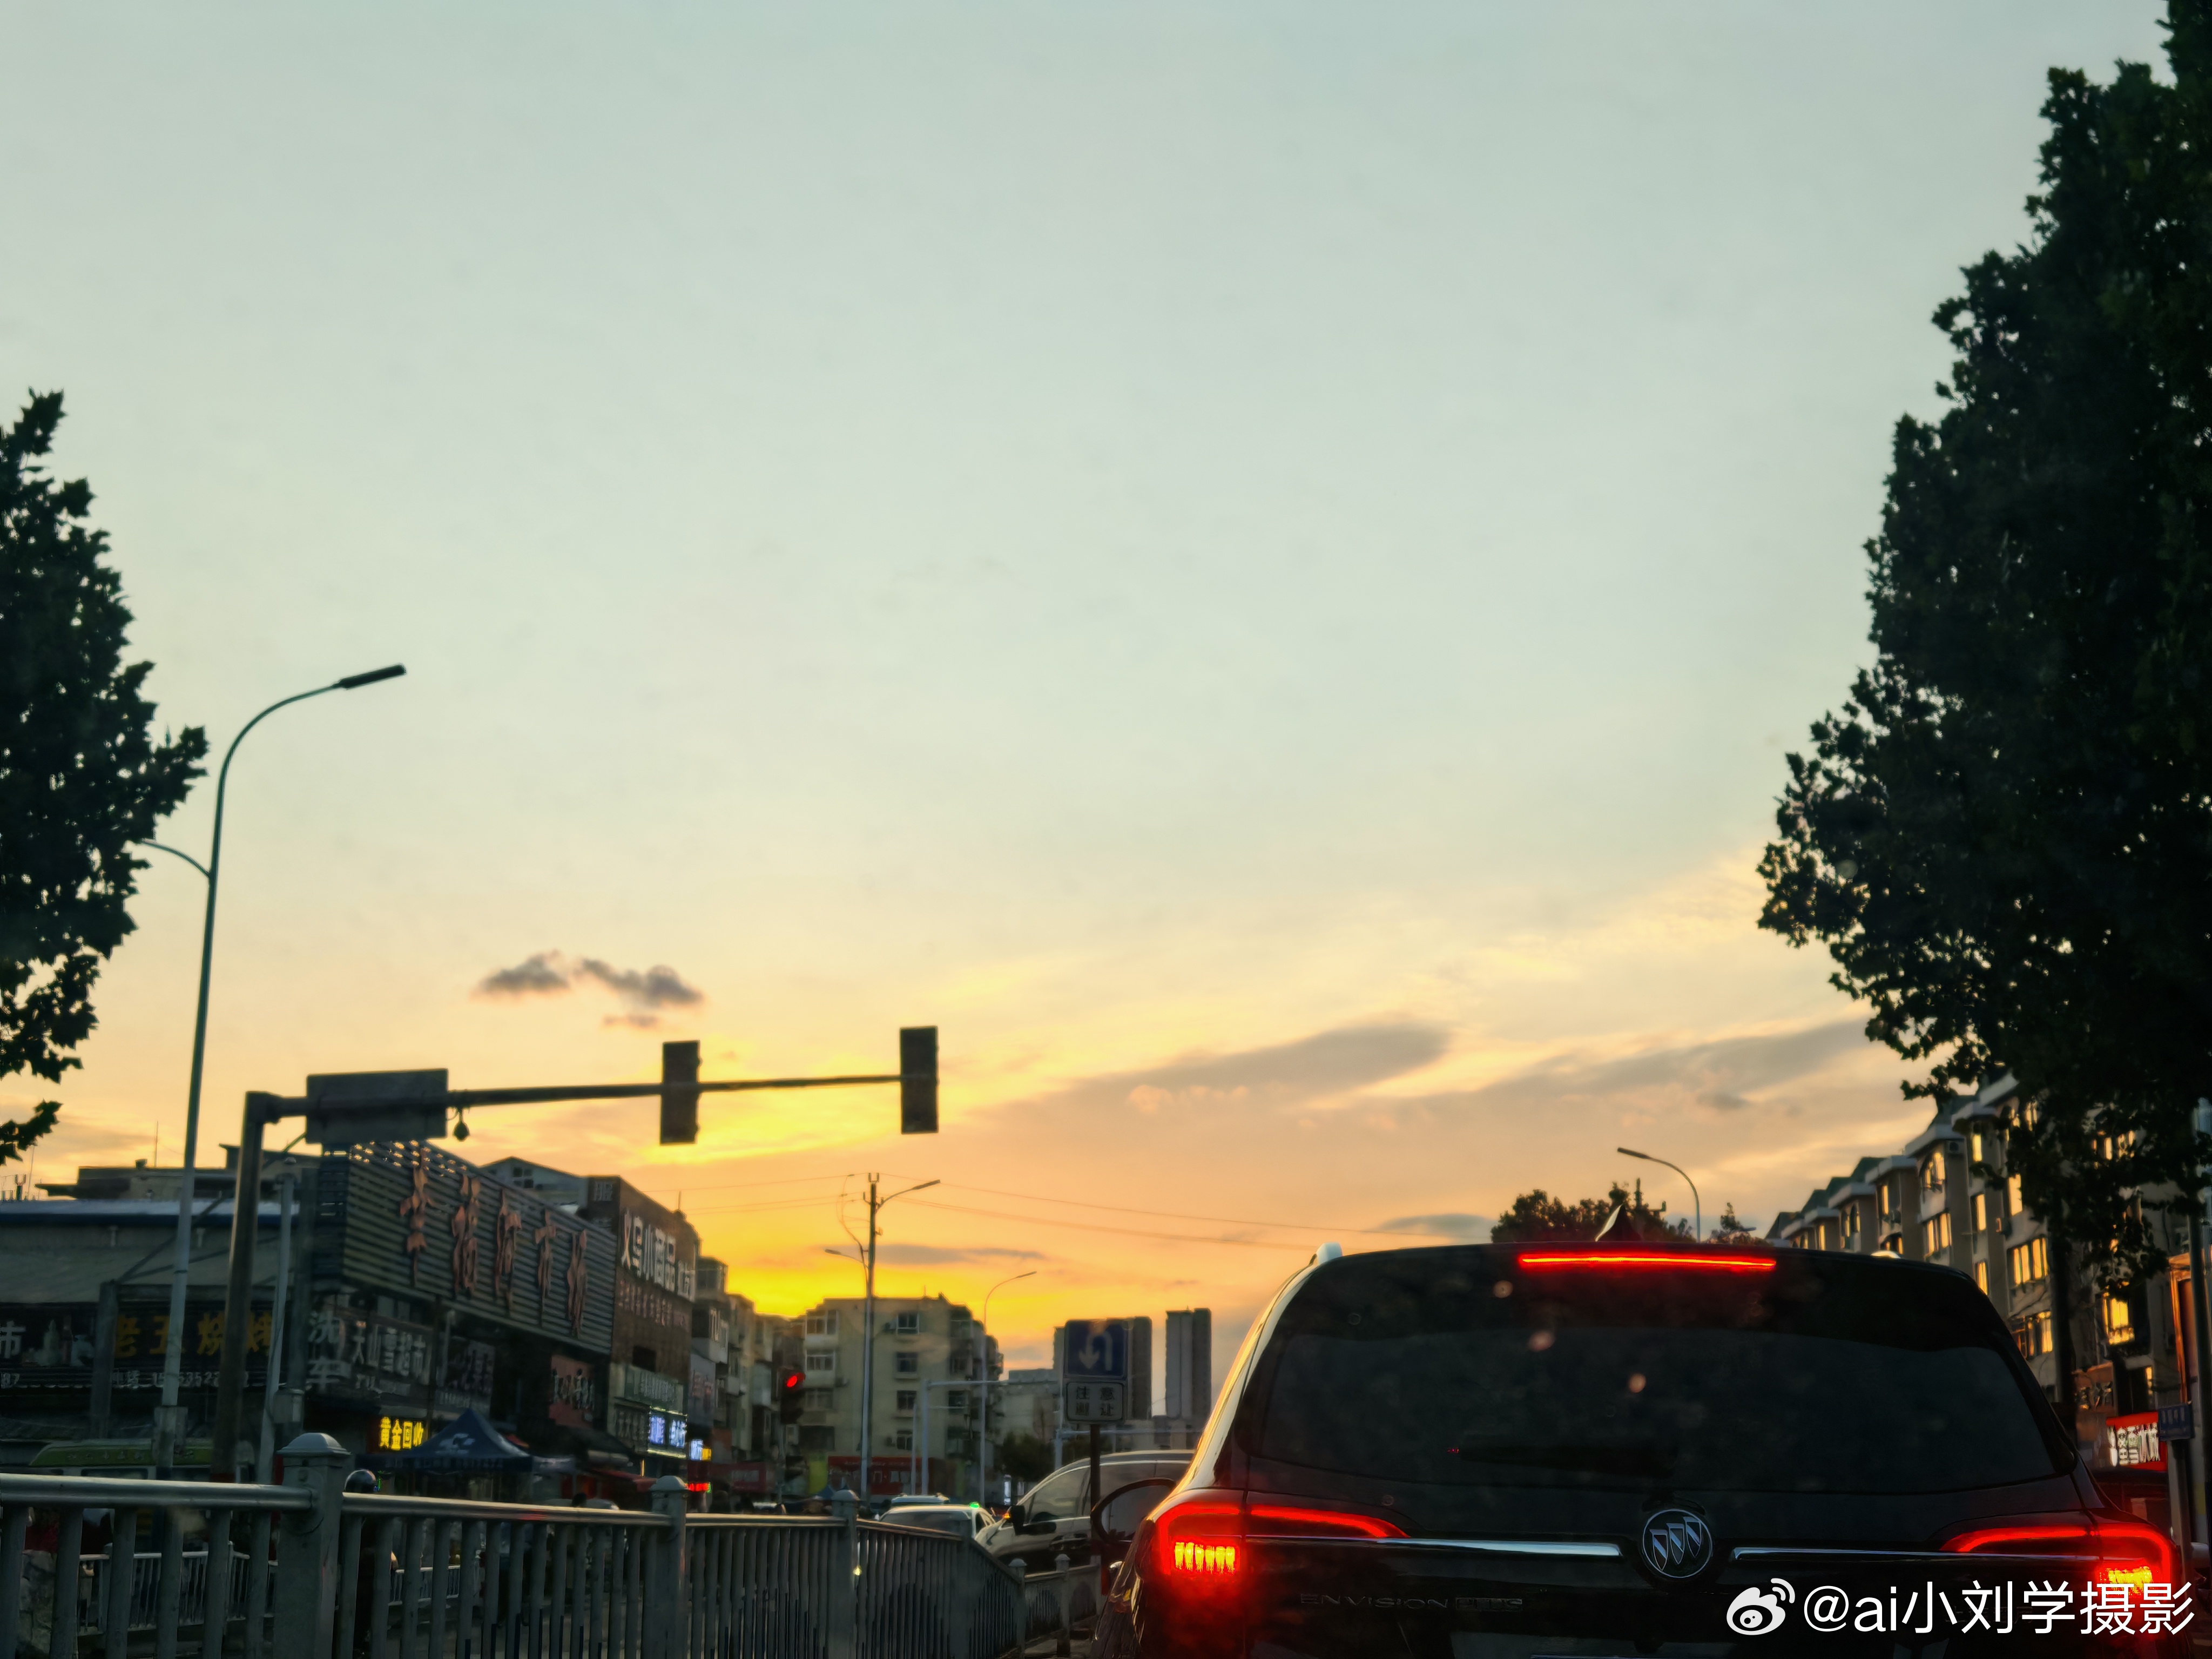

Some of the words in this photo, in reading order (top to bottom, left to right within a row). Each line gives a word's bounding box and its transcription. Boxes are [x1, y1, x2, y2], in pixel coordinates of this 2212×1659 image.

[379, 1416, 424, 1451] 黄金回收
[1300, 1594, 1448, 1609] ENVISION
